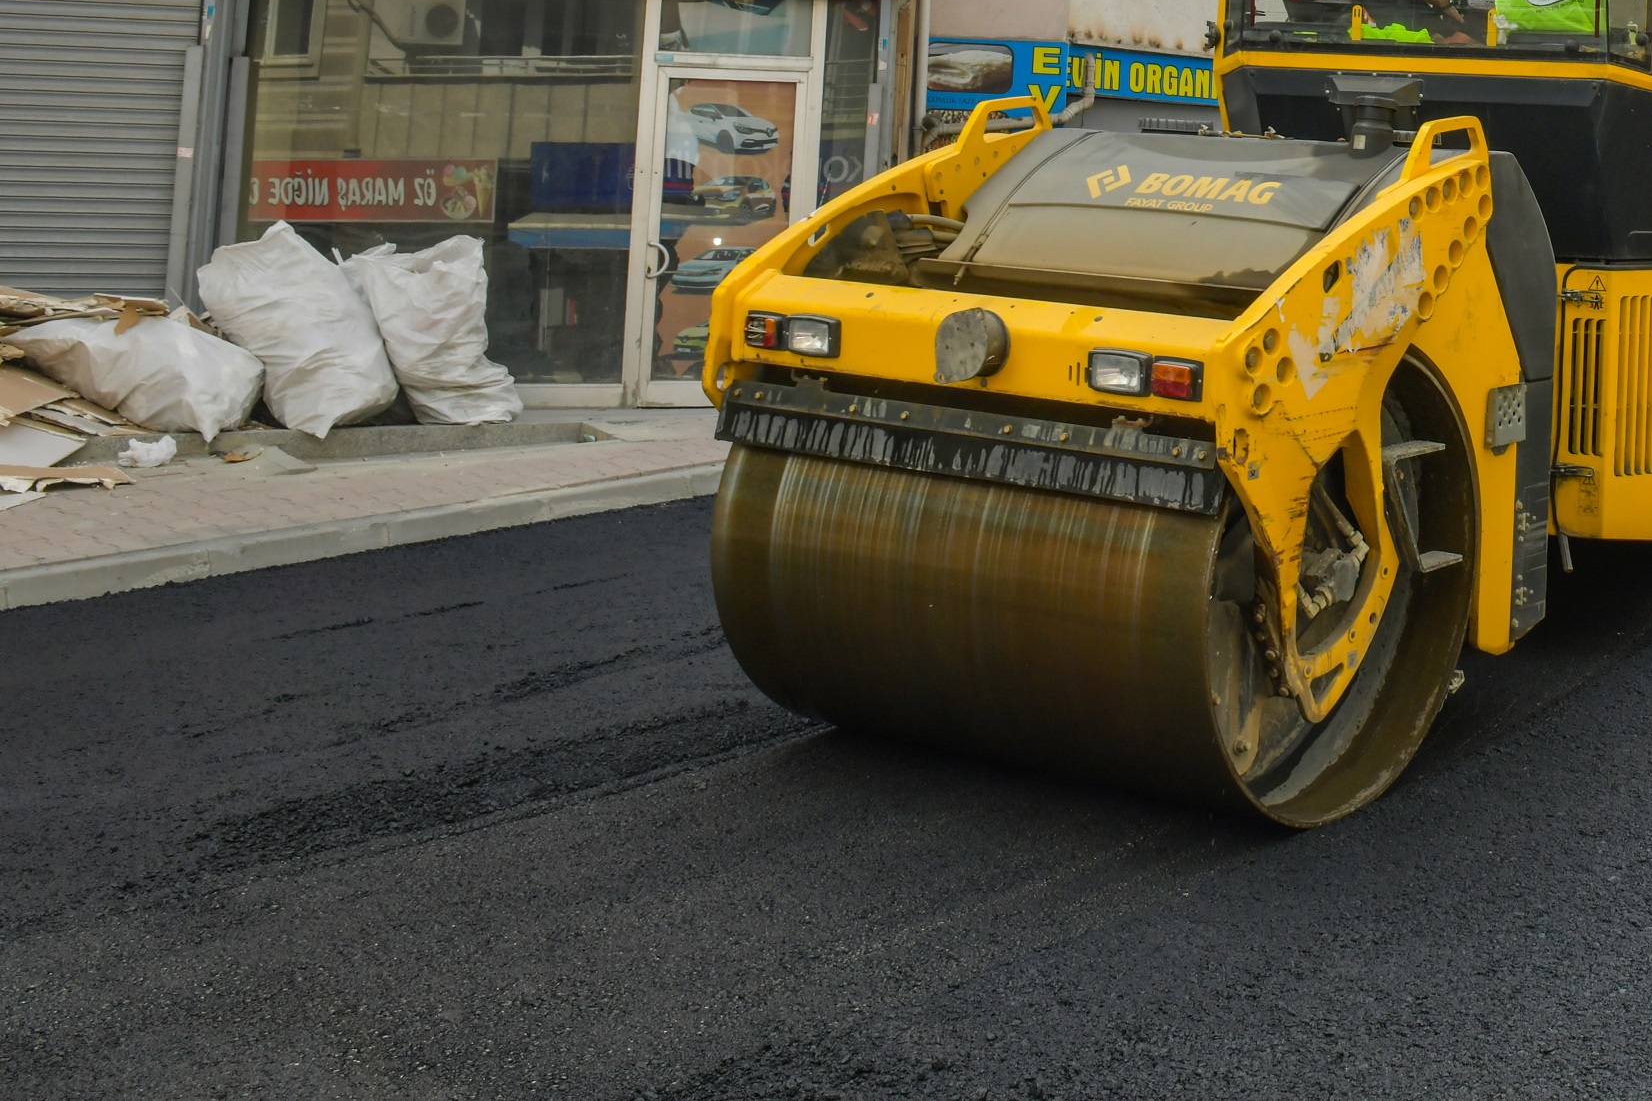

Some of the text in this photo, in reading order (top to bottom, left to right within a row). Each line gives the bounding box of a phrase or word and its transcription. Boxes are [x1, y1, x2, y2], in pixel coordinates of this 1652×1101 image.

[1135, 172, 1282, 205] BOMAG
[1124, 197, 1214, 213] FAYAT GROUP
